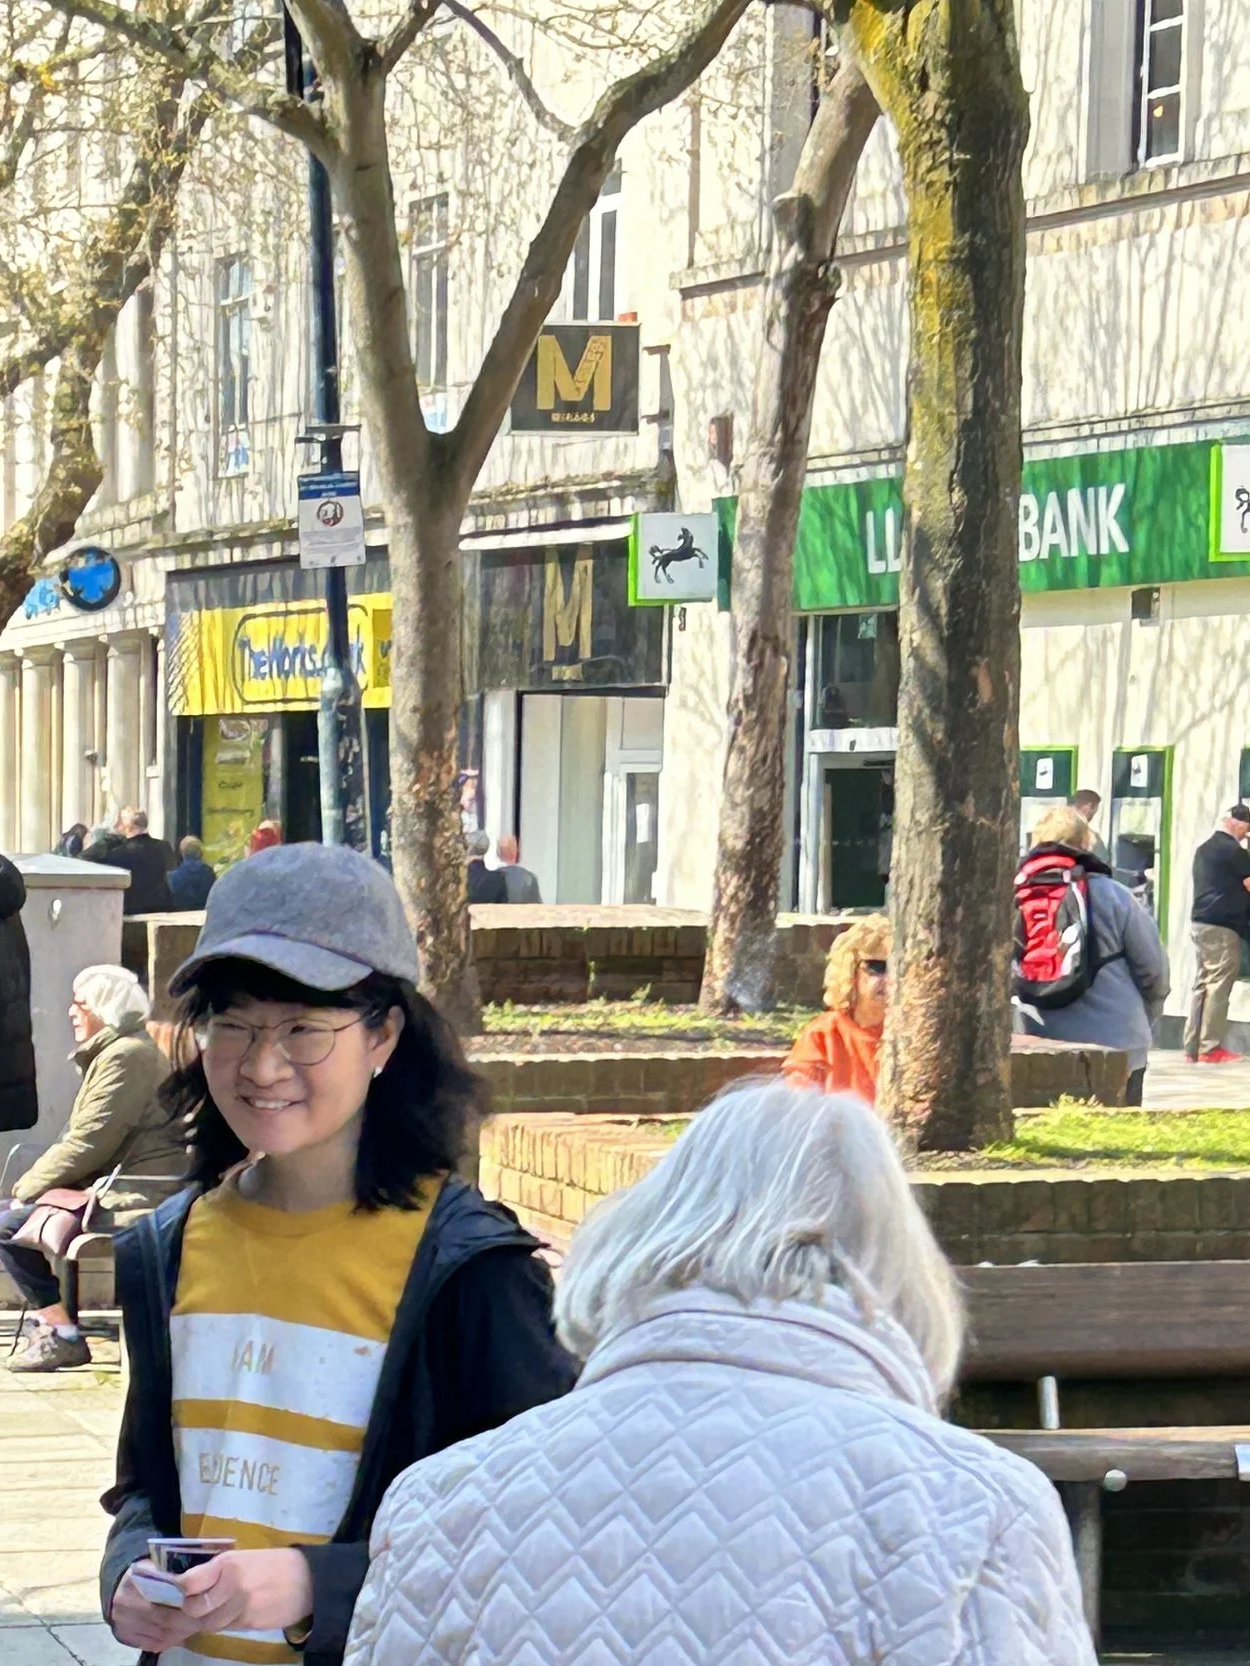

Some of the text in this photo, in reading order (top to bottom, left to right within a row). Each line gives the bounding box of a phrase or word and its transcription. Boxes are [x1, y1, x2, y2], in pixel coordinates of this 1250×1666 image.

[536, 334, 612, 411] M
[1017, 483, 1129, 562] BANK
[542, 542, 593, 662] M
